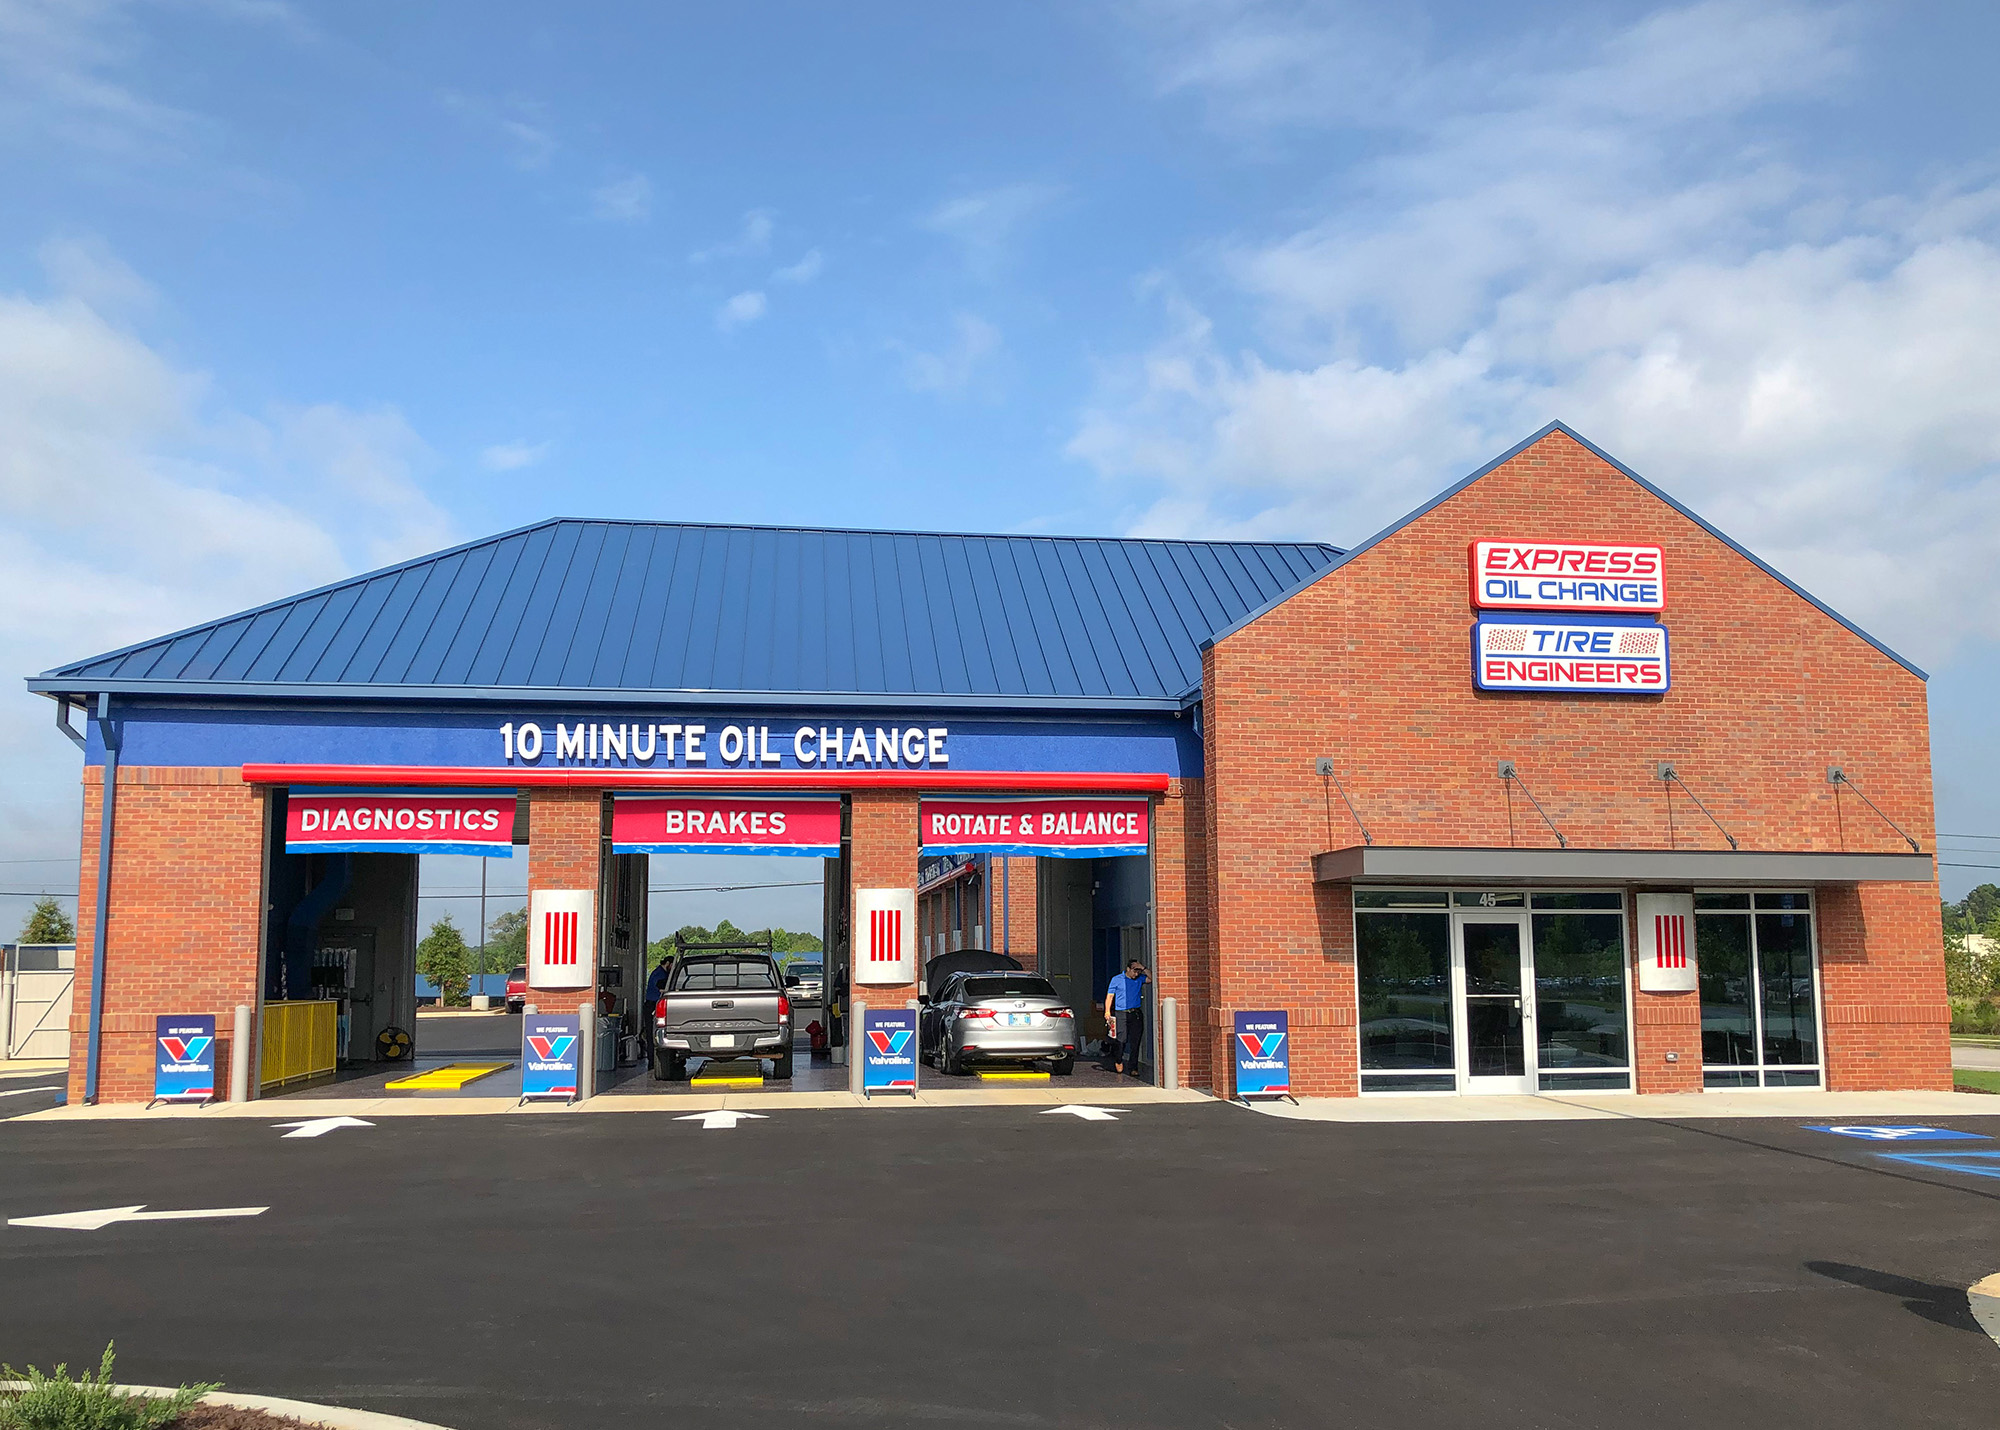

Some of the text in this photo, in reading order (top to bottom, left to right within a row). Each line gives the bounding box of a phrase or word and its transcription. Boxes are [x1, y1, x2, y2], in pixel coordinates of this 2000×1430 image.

[1485, 547, 1658, 574] EXPRESS
[1485, 579, 1658, 603] OIL CHANGE
[1532, 629, 1614, 654] TIRE
[1485, 660, 1662, 684] ENGINEERS
[500, 722, 950, 764] 10 MINUTE OIL CHANGE
[301, 807, 501, 832] DIAGNOSTICS
[666, 809, 787, 835] BRAKES
[931, 811, 1140, 836] ROTATE & BALANCE
[1479, 892, 1497, 907] 45
[690, 1021, 757, 1029] TACOMA
[527, 1061, 573, 1071] Valvoline
[868, 1056, 911, 1065] Valvoline
[1240, 1060, 1284, 1070] Valvoline
